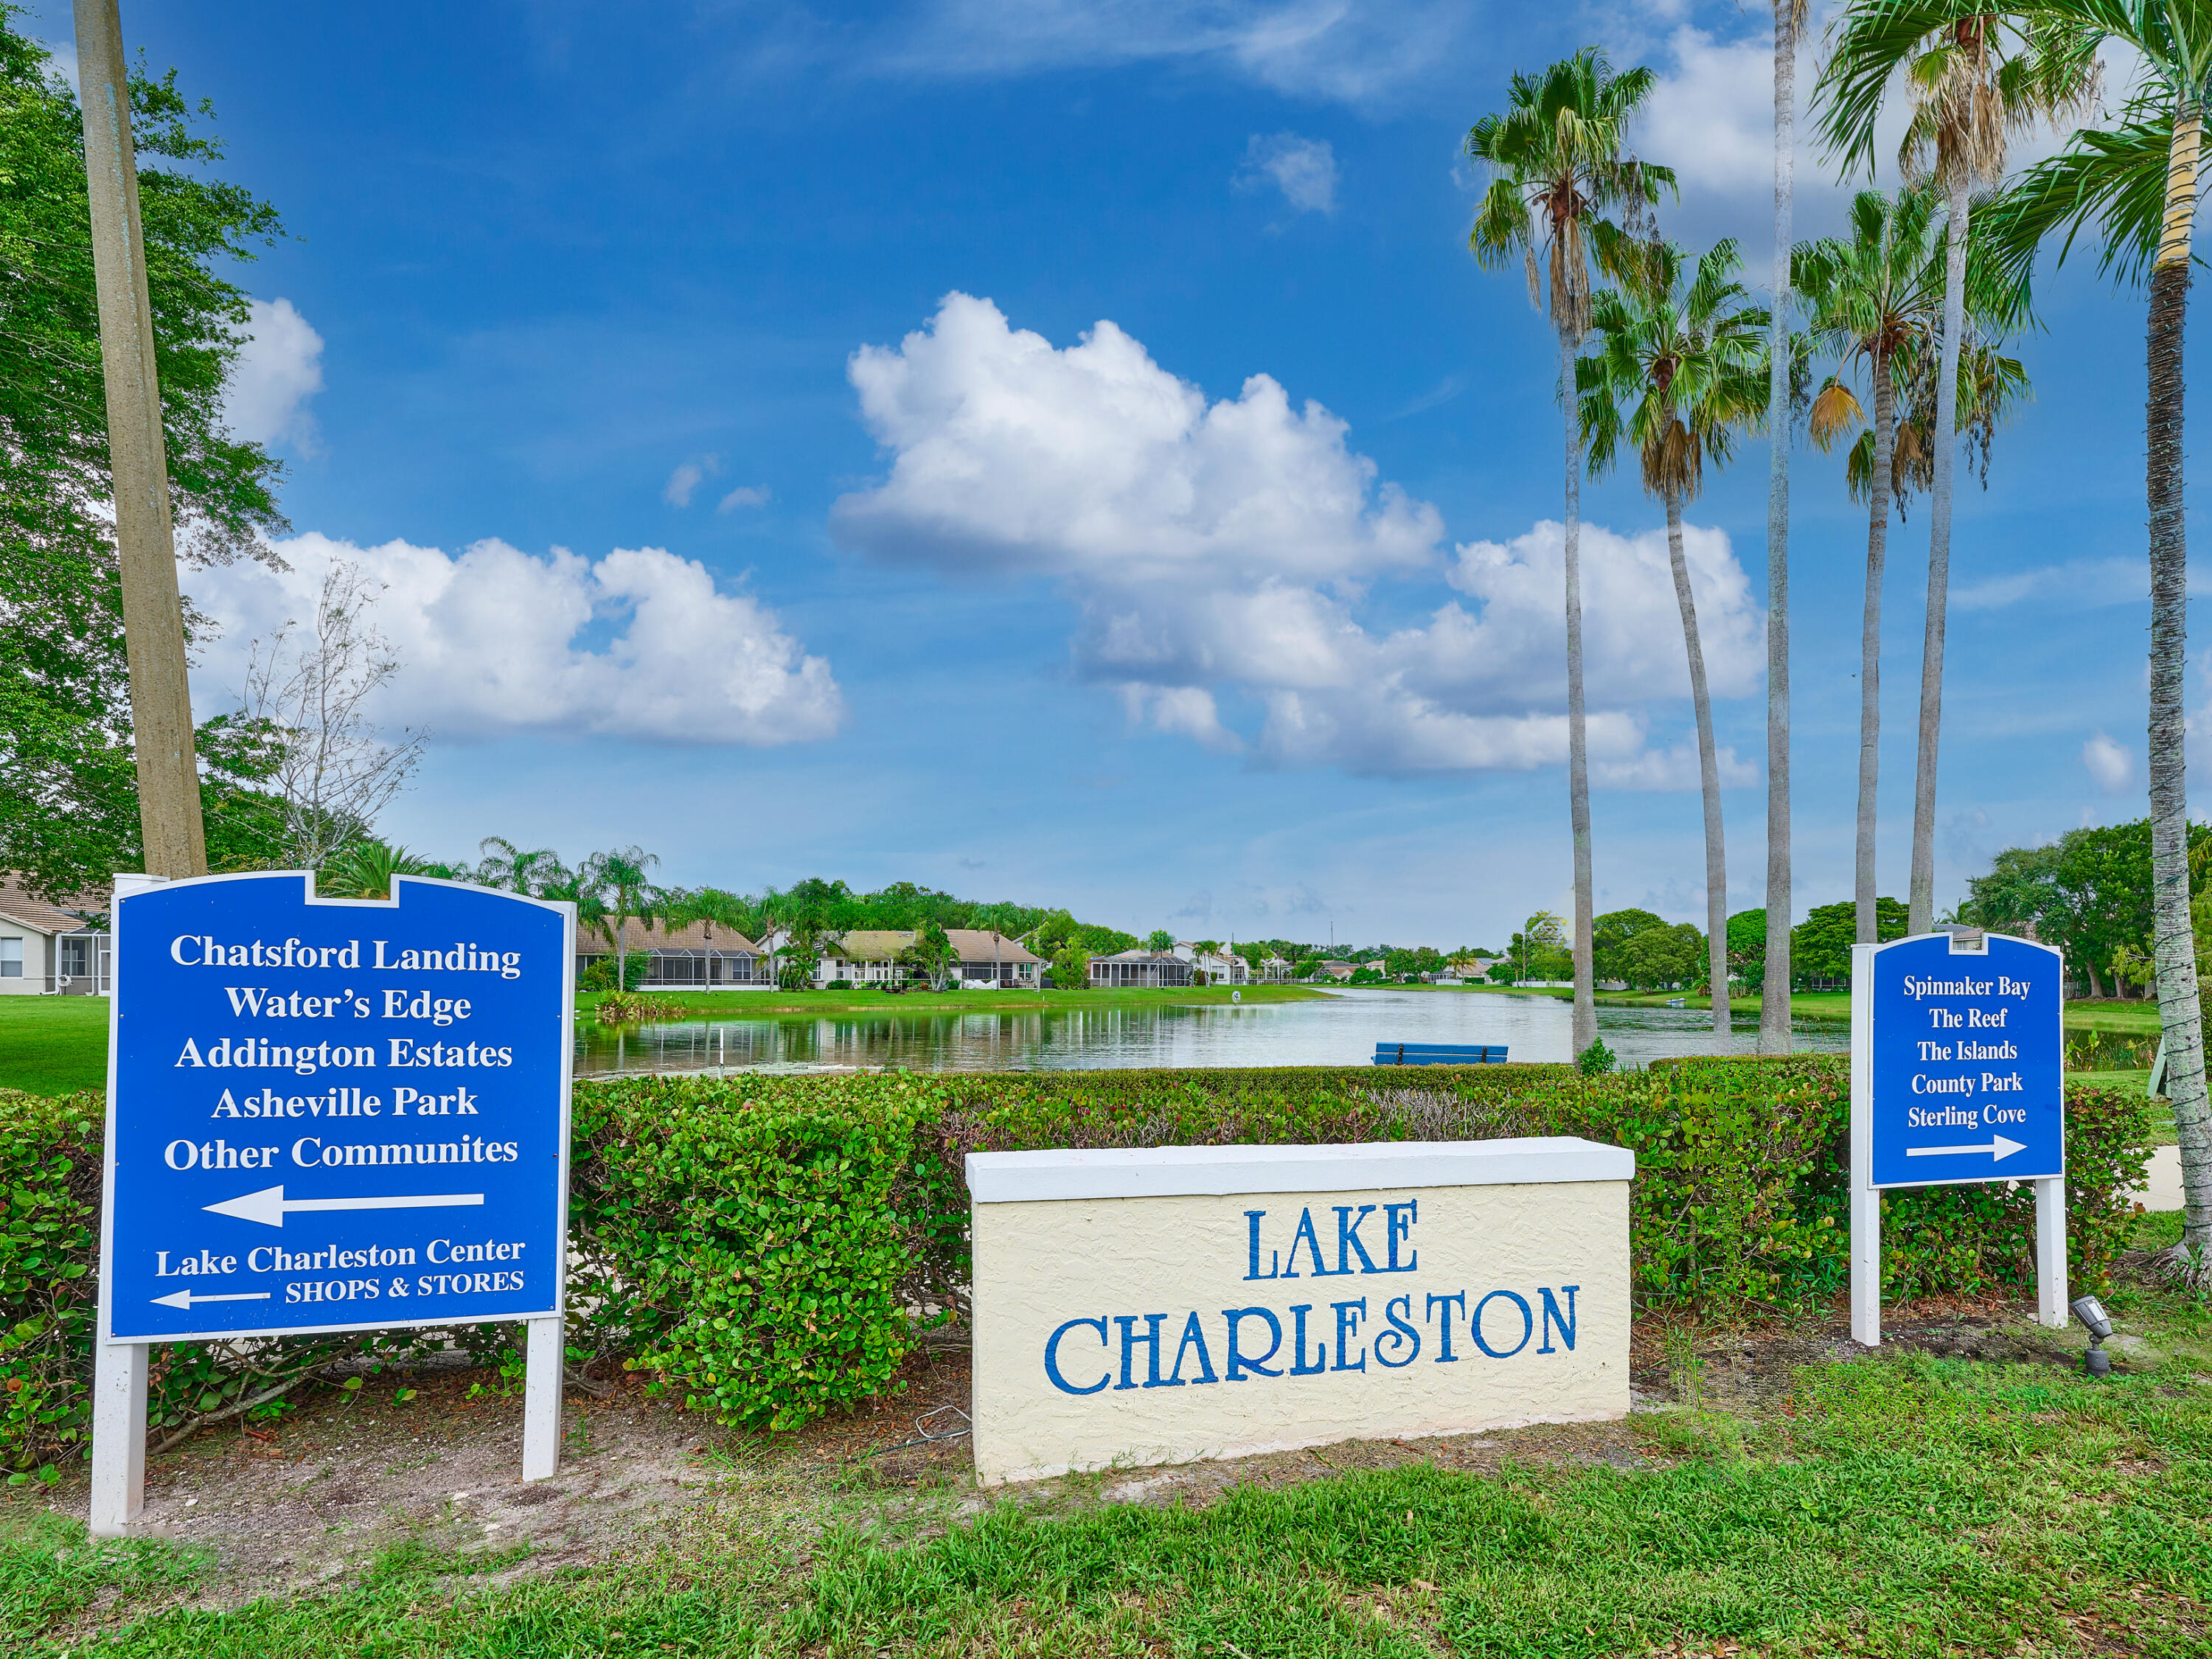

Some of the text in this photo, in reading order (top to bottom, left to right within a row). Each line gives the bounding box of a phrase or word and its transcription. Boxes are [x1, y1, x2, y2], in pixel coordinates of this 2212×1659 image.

[170, 935, 521, 980] Chatsford Landing
[1904, 975, 2031, 1001] Spinnaker Bay
[223, 987, 471, 1026] Water's Edge
[1929, 1007, 2008, 1028] The Reef
[174, 1037, 512, 1075] Addington Estates
[1917, 1040, 2017, 1061] The Islands
[1911, 1071, 2024, 1098] County Park
[210, 1087, 479, 1118] Asheville Park
[1908, 1104, 2026, 1130] Sterling Cove
[164, 1134, 518, 1170] Other Communites
[1242, 1198, 1418, 1281] LAKE
[155, 1239, 526, 1277] Lake Charleston Center
[285, 1270, 524, 1304] SHOPS & STORES
[1044, 1285, 1580, 1396] CHARLESTON
